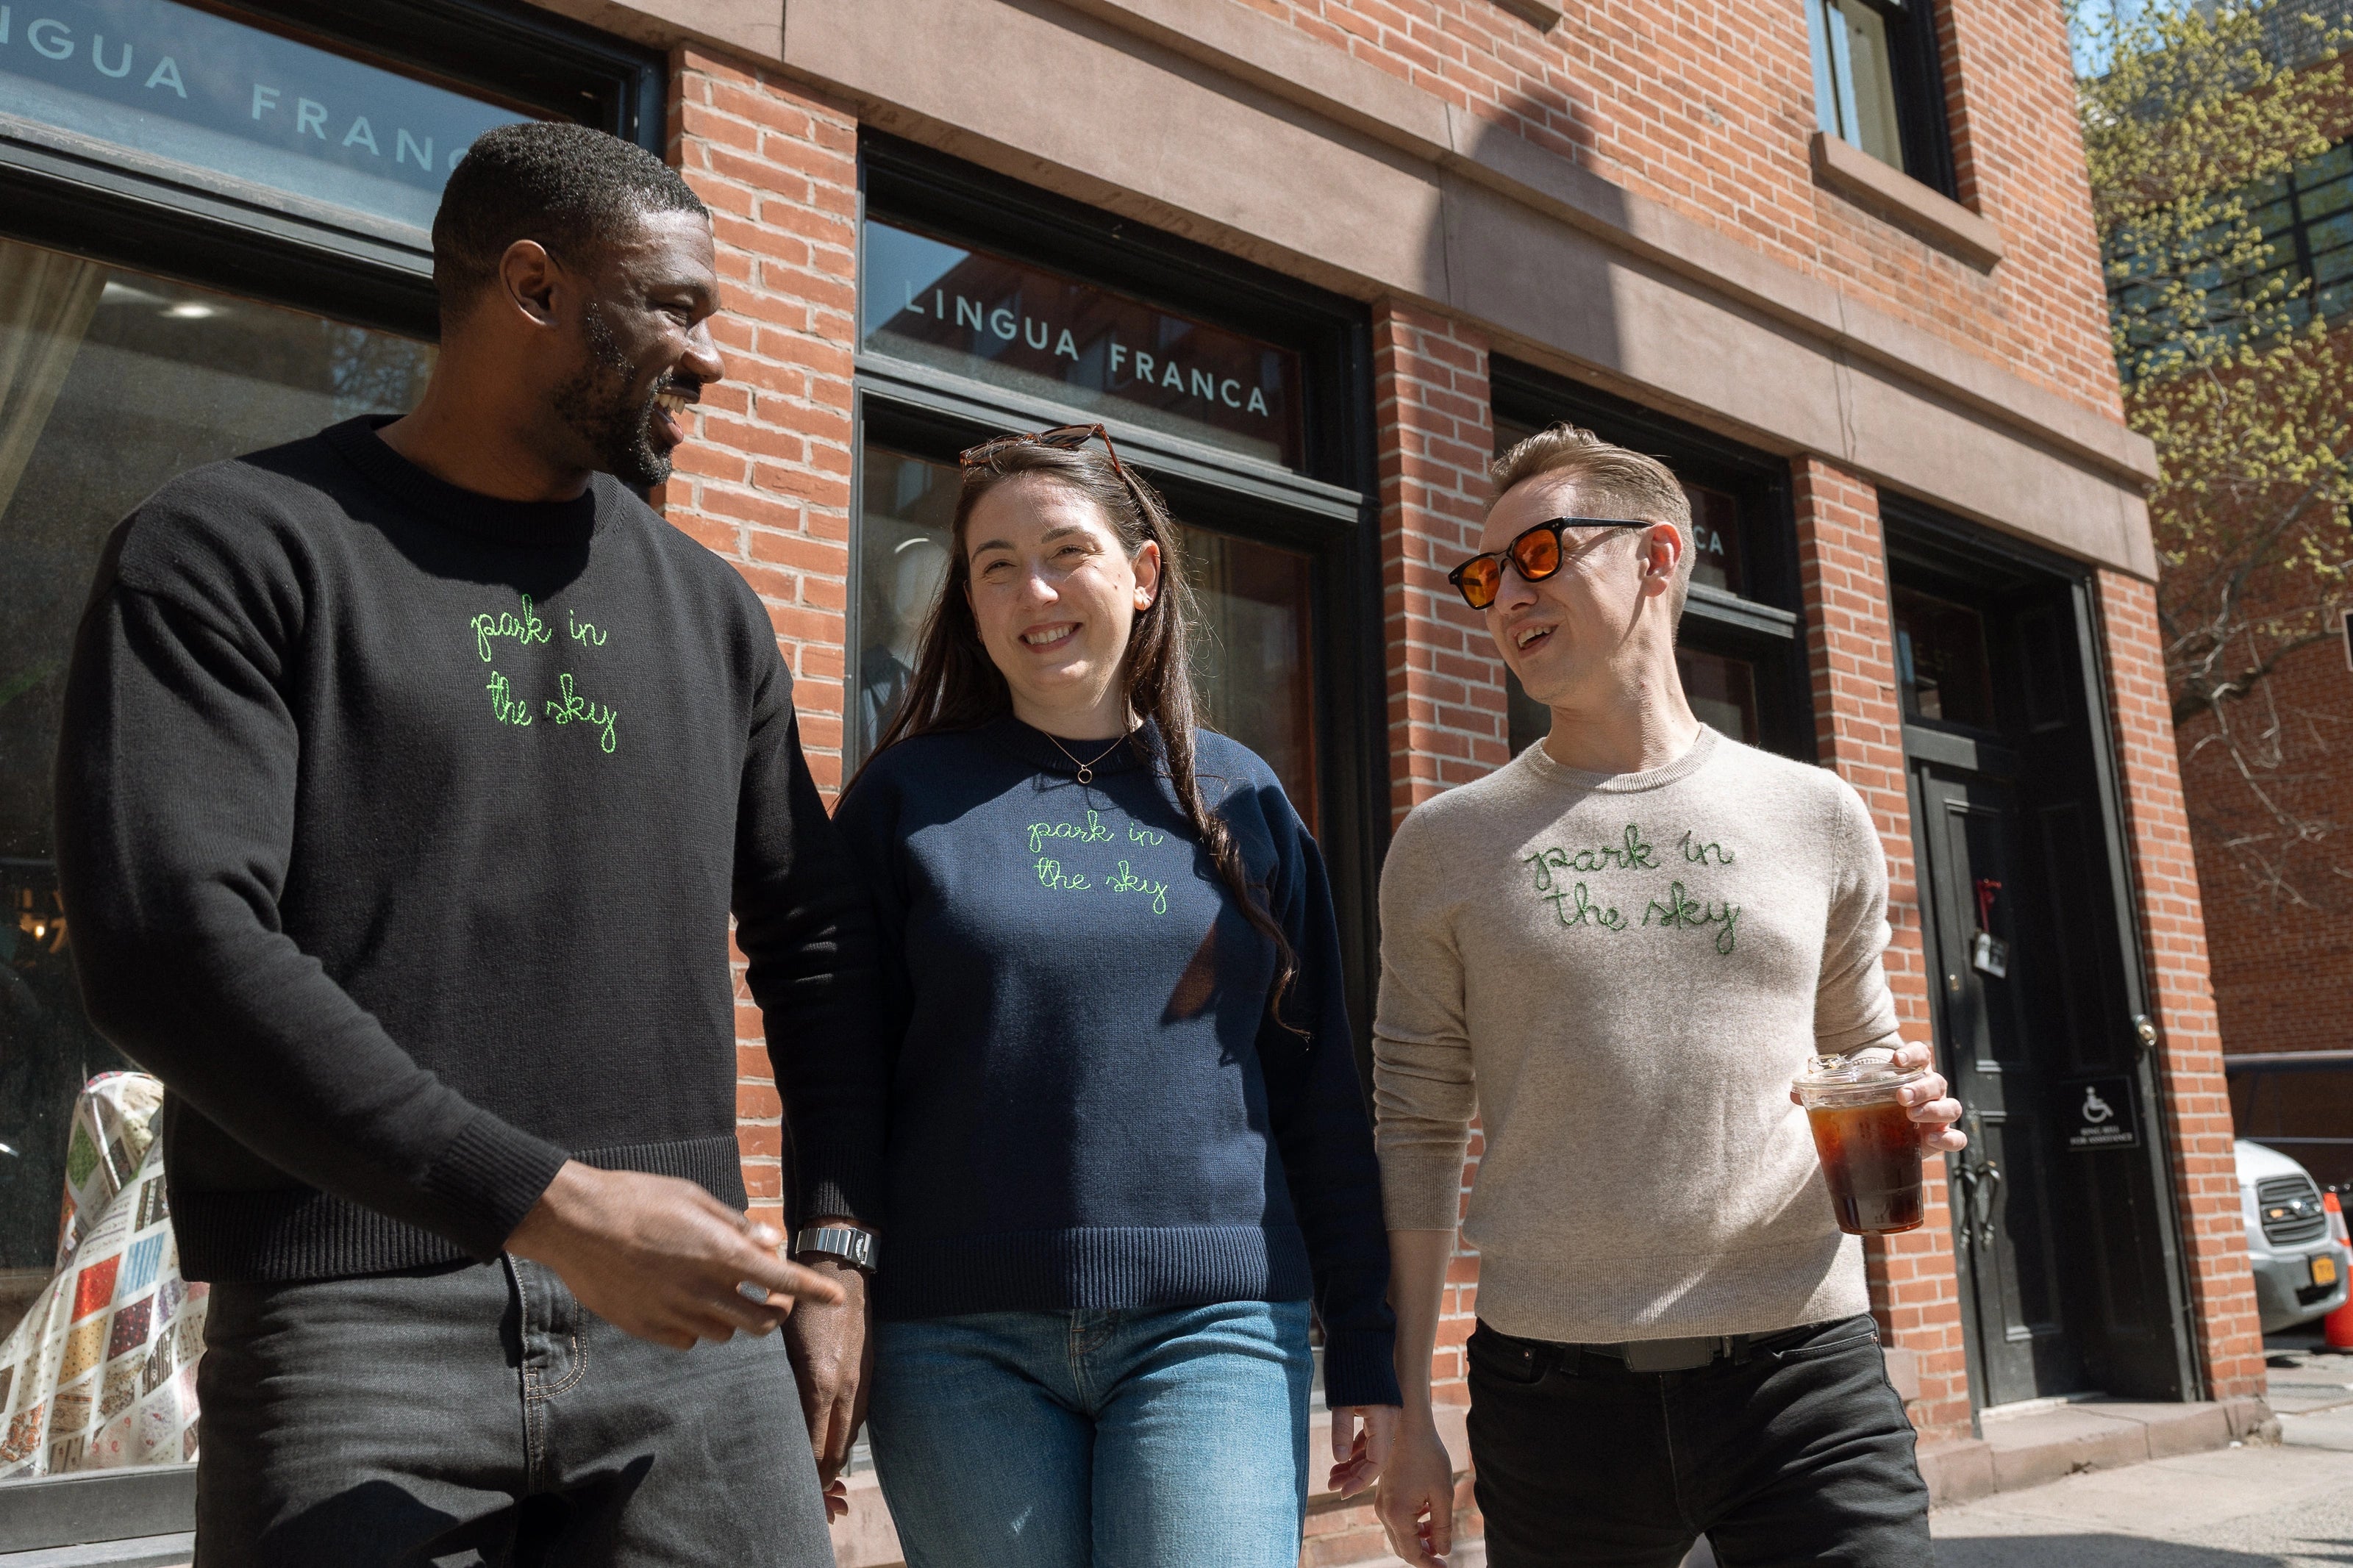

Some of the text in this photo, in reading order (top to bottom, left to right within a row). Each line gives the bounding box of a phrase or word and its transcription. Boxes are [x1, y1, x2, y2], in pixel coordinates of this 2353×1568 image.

[905, 281, 1268, 417] LINGUA FRANCA
[471, 593, 607, 662] park in
[486, 670, 617, 753] the sky
[1027, 810, 1164, 853] park in
[1523, 823, 1735, 891] park in
[1032, 857, 1168, 914] the sky
[1543, 880, 1740, 955] the sky
